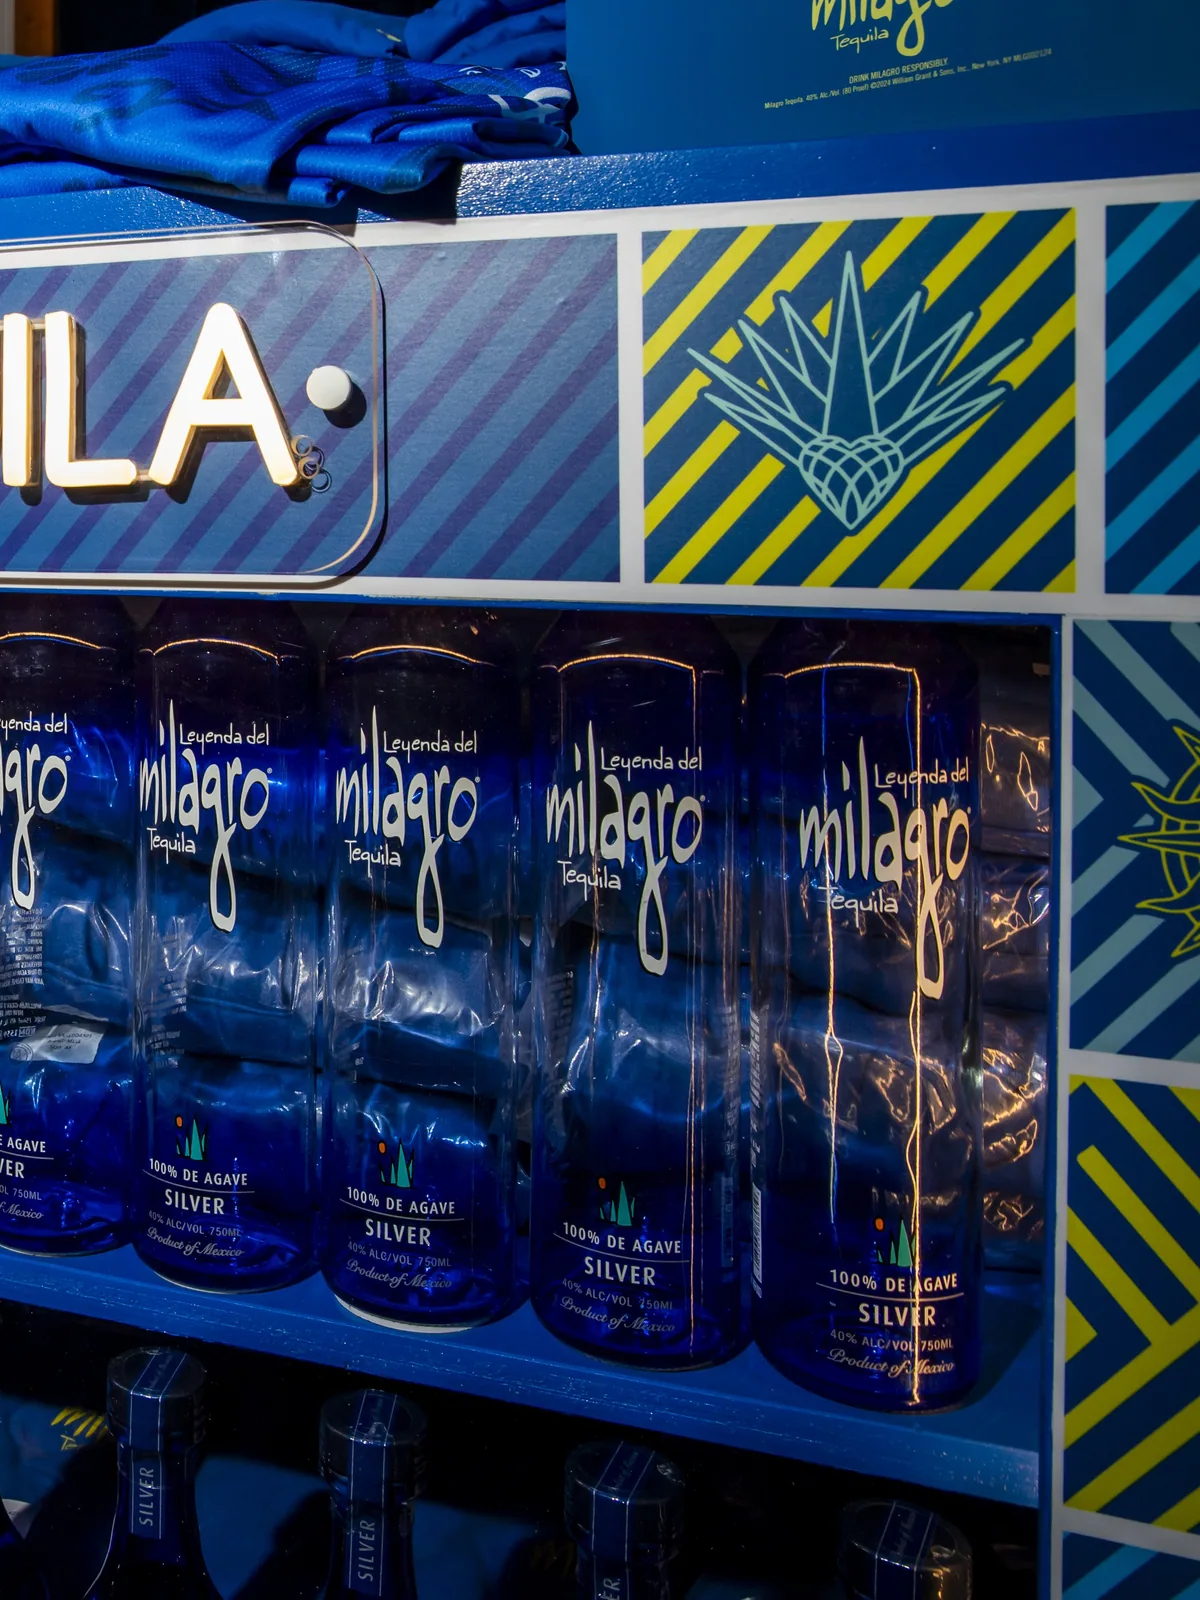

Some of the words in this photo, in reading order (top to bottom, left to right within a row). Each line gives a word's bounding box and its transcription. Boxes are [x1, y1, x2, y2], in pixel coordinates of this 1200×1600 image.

[830, 27, 889, 54] Tequila
[849, 73, 869, 84] DRINK
[871, 67, 900, 80] MILAGRO
[764, 101, 784, 109] Milagro
[44, 712, 68, 734] del
[179, 722, 243, 755] Leyenda
[246, 722, 269, 745] del
[383, 729, 450, 763] Leyenda
[453, 729, 477, 754] del
[600, 746, 674, 781] Leyenda
[678, 746, 702, 771] del
[875, 758, 947, 799] Leyenda
[951, 756, 969, 783] del
[139, 698, 269, 933] milagro
[335, 704, 477, 949] milagro
[146, 826, 196, 865] Tequila
[344, 839, 401, 878] Tequila
[546, 719, 702, 977] milagro
[557, 860, 622, 901] Tequila
[800, 736, 970, 1000] milagro
[818, 886, 899, 928] Tequila
[7, 1136, 46, 1153] AGAVE
[148, 1157, 178, 1179] 100%
[182, 1168, 198, 1183] DE
[203, 1172, 248, 1186] AGAVE
[13, 1187, 42, 1201] 750ML
[164, 1188, 225, 1215] SILVER
[346, 1185, 380, 1209] 100%
[385, 1197, 403, 1212] DE
[409, 1200, 455, 1215] AGAVE
[4, 1203, 44, 1220] Mexico
[148, 1209, 164, 1226] 40%
[165, 1215, 204, 1236] ALC/VOL
[209, 1225, 242, 1238] 750ML
[147, 1226, 185, 1252] Product
[183, 1241, 201, 1257] of
[197, 1242, 245, 1258] Mexico
[365, 1217, 431, 1247] SILVER
[562, 1221, 600, 1245] 100%
[607, 1234, 625, 1251] DE
[632, 1239, 682, 1255] AGAVE
[347, 1239, 367, 1256] 40%
[368, 1246, 413, 1267] ALC/VOL
[417, 1252, 452, 1268] 750ML
[346, 1258, 391, 1285] Product
[389, 1271, 407, 1290] of
[403, 1272, 453, 1290] Mexico
[584, 1255, 656, 1287] SILVER
[830, 1268, 877, 1291] 100%
[886, 1278, 905, 1293] DE
[913, 1272, 958, 1293] AGAVE
[561, 1276, 583, 1294] 40%
[585, 1285, 633, 1309] ALC/VOL
[639, 1296, 674, 1311] 750ML
[559, 1296, 608, 1325] Product
[608, 1312, 628, 1332] of
[624, 1315, 676, 1334] Mexico
[858, 1302, 936, 1327] SILVER
[830, 1328, 858, 1345] 40%
[861, 1335, 914, 1353] ALC/VOL
[921, 1337, 954, 1352] 750ML
[826, 1347, 889, 1373] Product
[888, 1359, 910, 1379] of
[908, 1359, 955, 1376] Mexico
[138, 1466, 154, 1527] SILVER
[357, 1519, 375, 1583] SILVER
